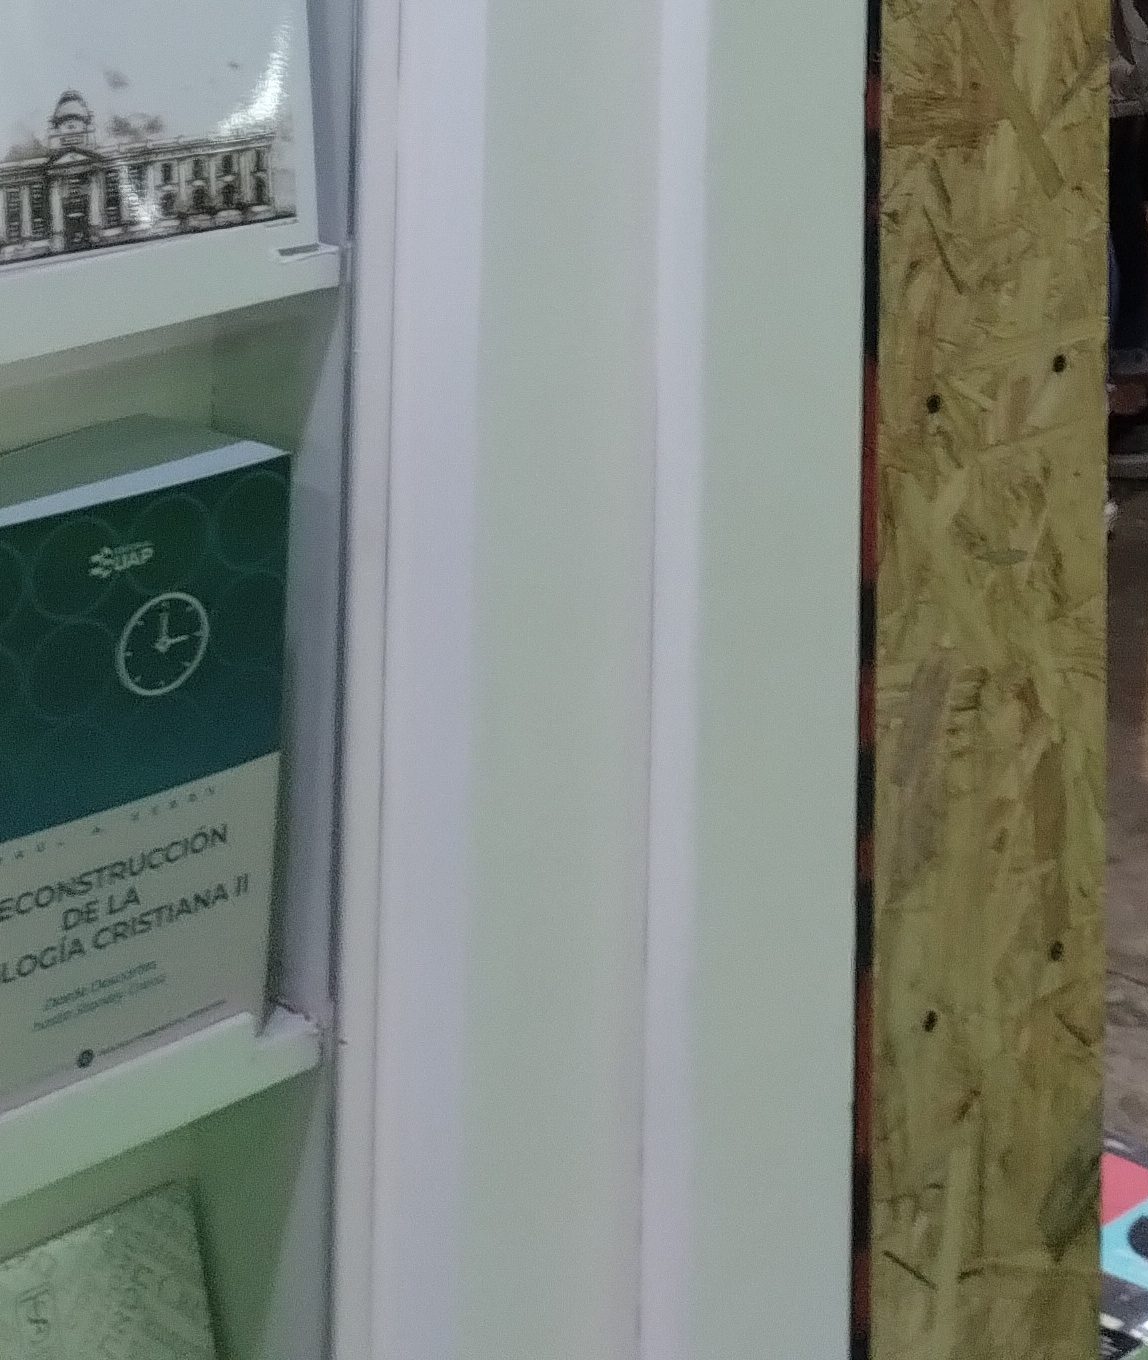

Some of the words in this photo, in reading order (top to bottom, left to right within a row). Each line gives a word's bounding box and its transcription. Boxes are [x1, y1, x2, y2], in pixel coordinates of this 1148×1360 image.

[62, 899, 99, 931] DE
[107, 886, 141, 915] LA
[92, 883, 229, 950] CRISTIANA
